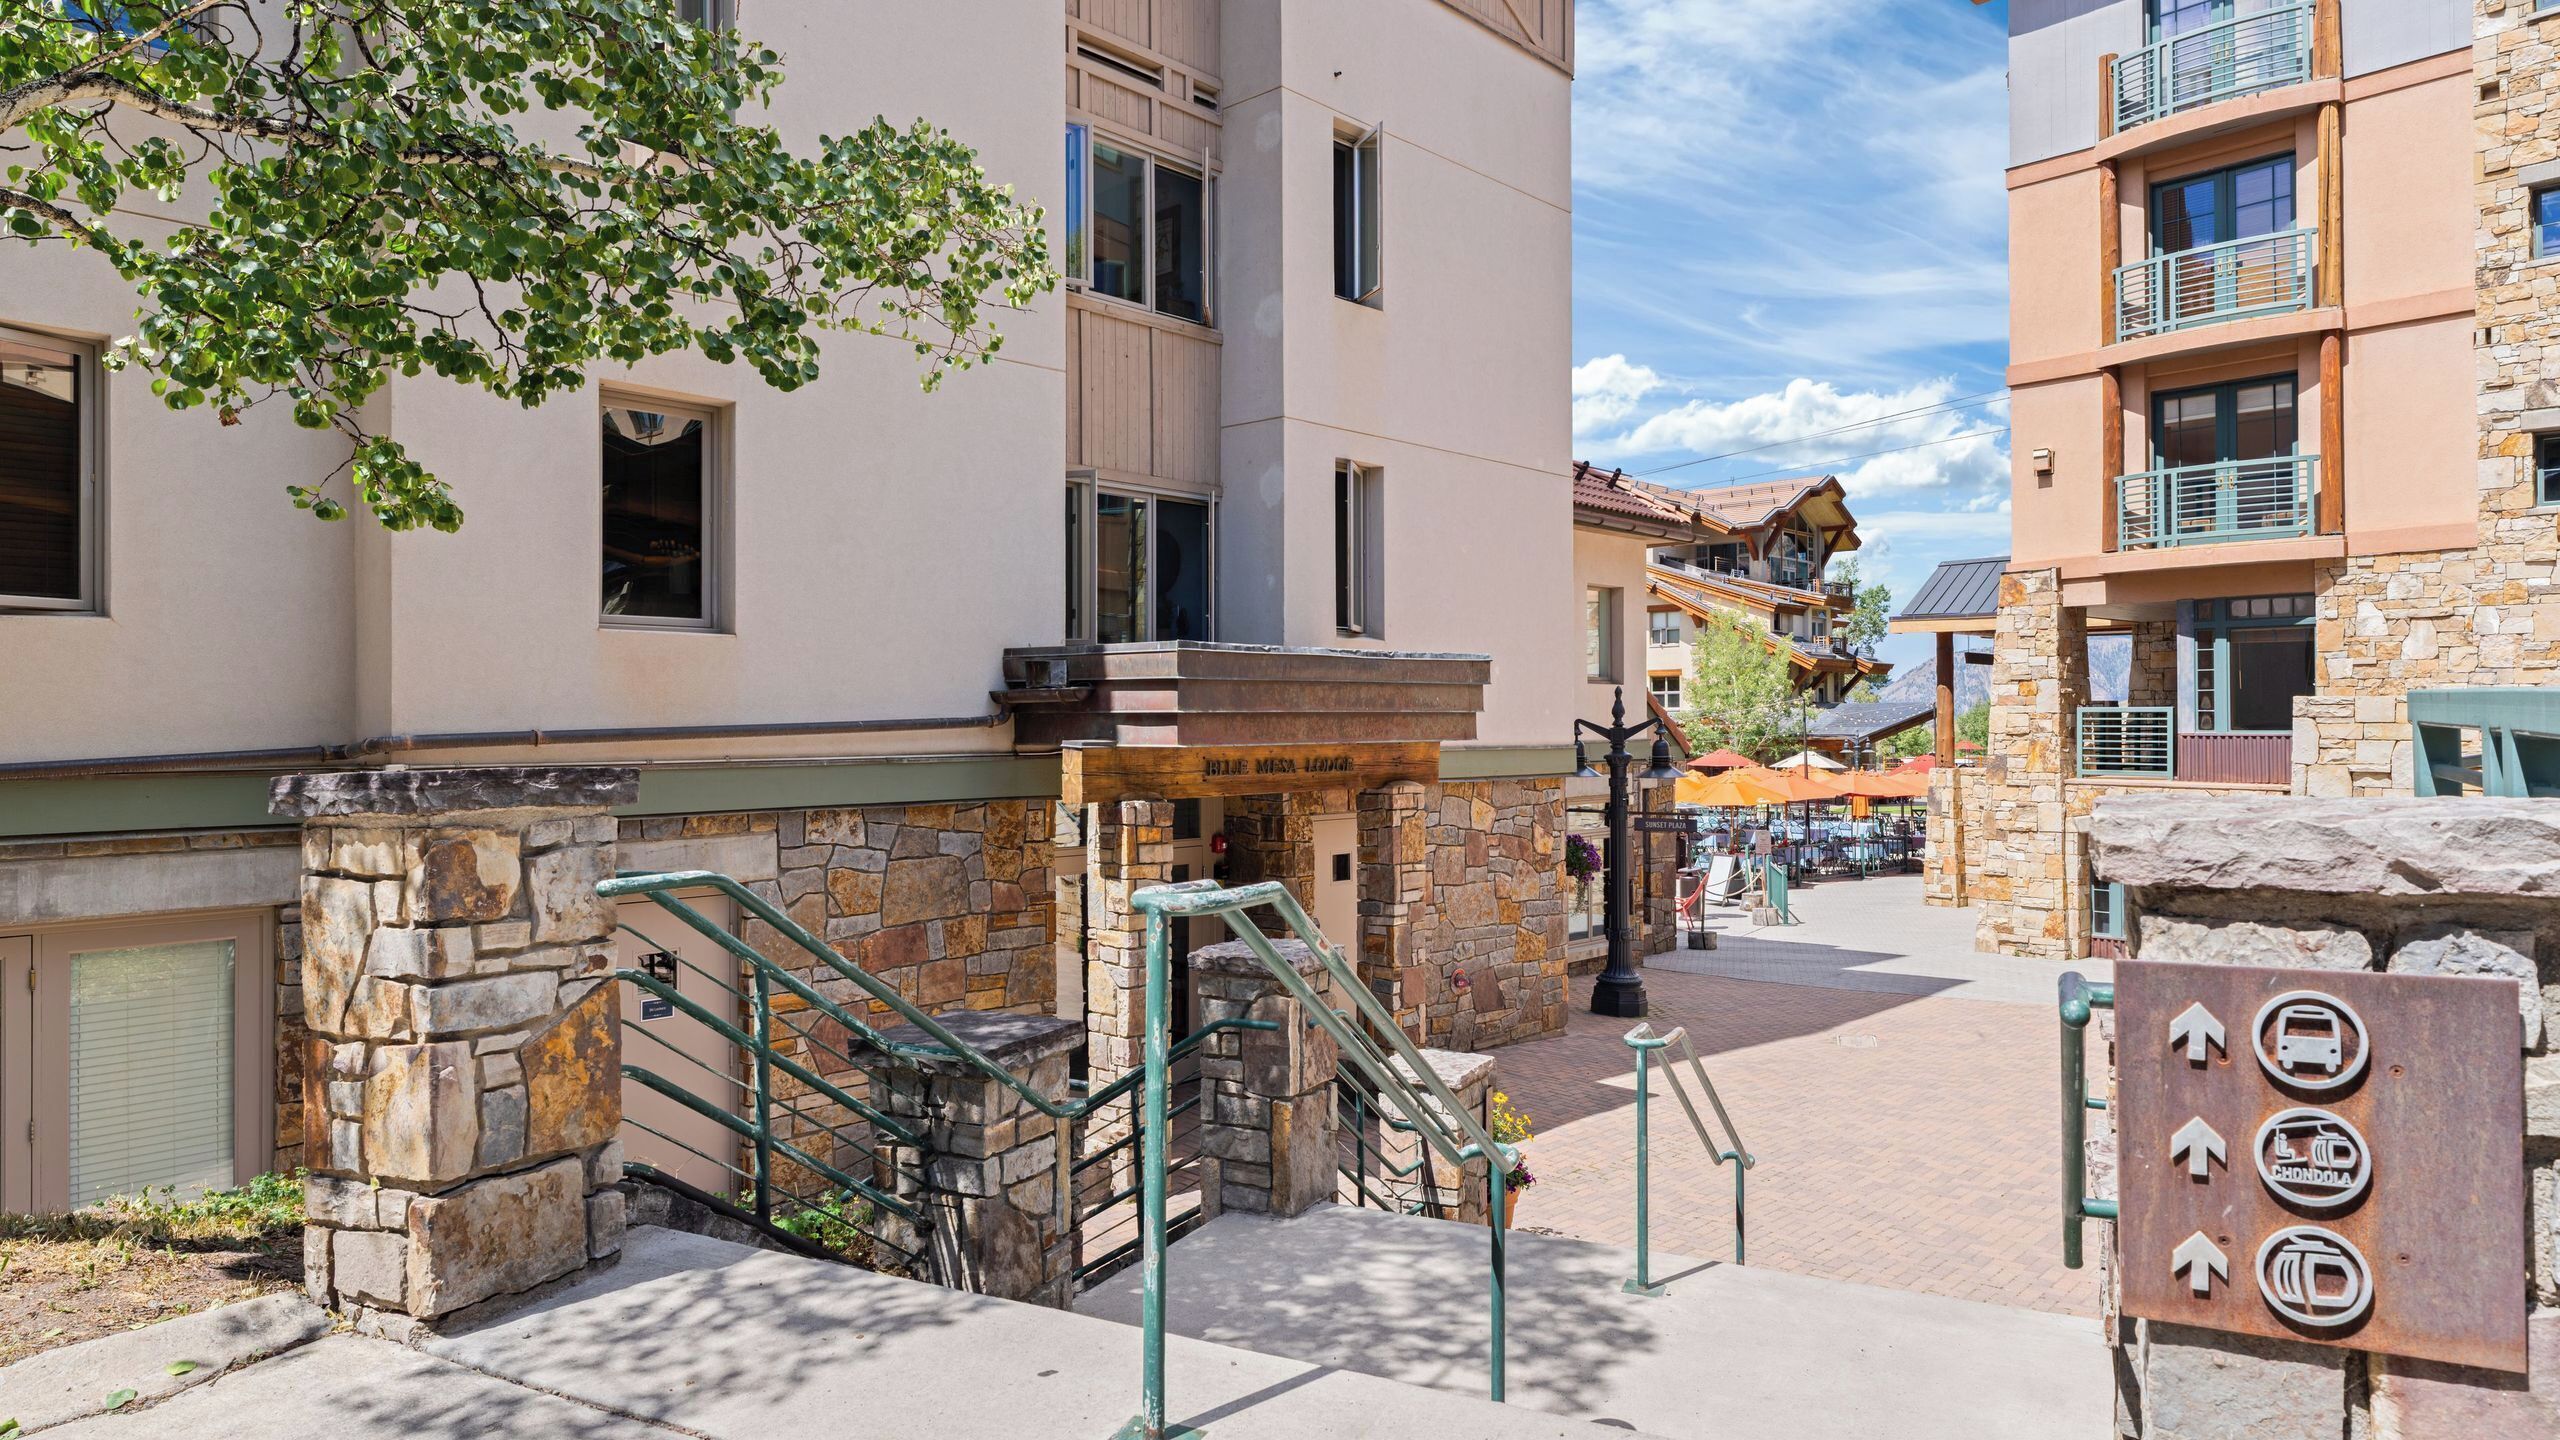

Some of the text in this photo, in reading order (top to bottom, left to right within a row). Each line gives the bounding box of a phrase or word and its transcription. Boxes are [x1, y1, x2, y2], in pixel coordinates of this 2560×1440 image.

[1205, 755, 1354, 776] BLUE MESA LODGE
[1645, 821, 1667, 829] SUNSET
[2271, 1164, 2353, 1187] CHONDOLA
